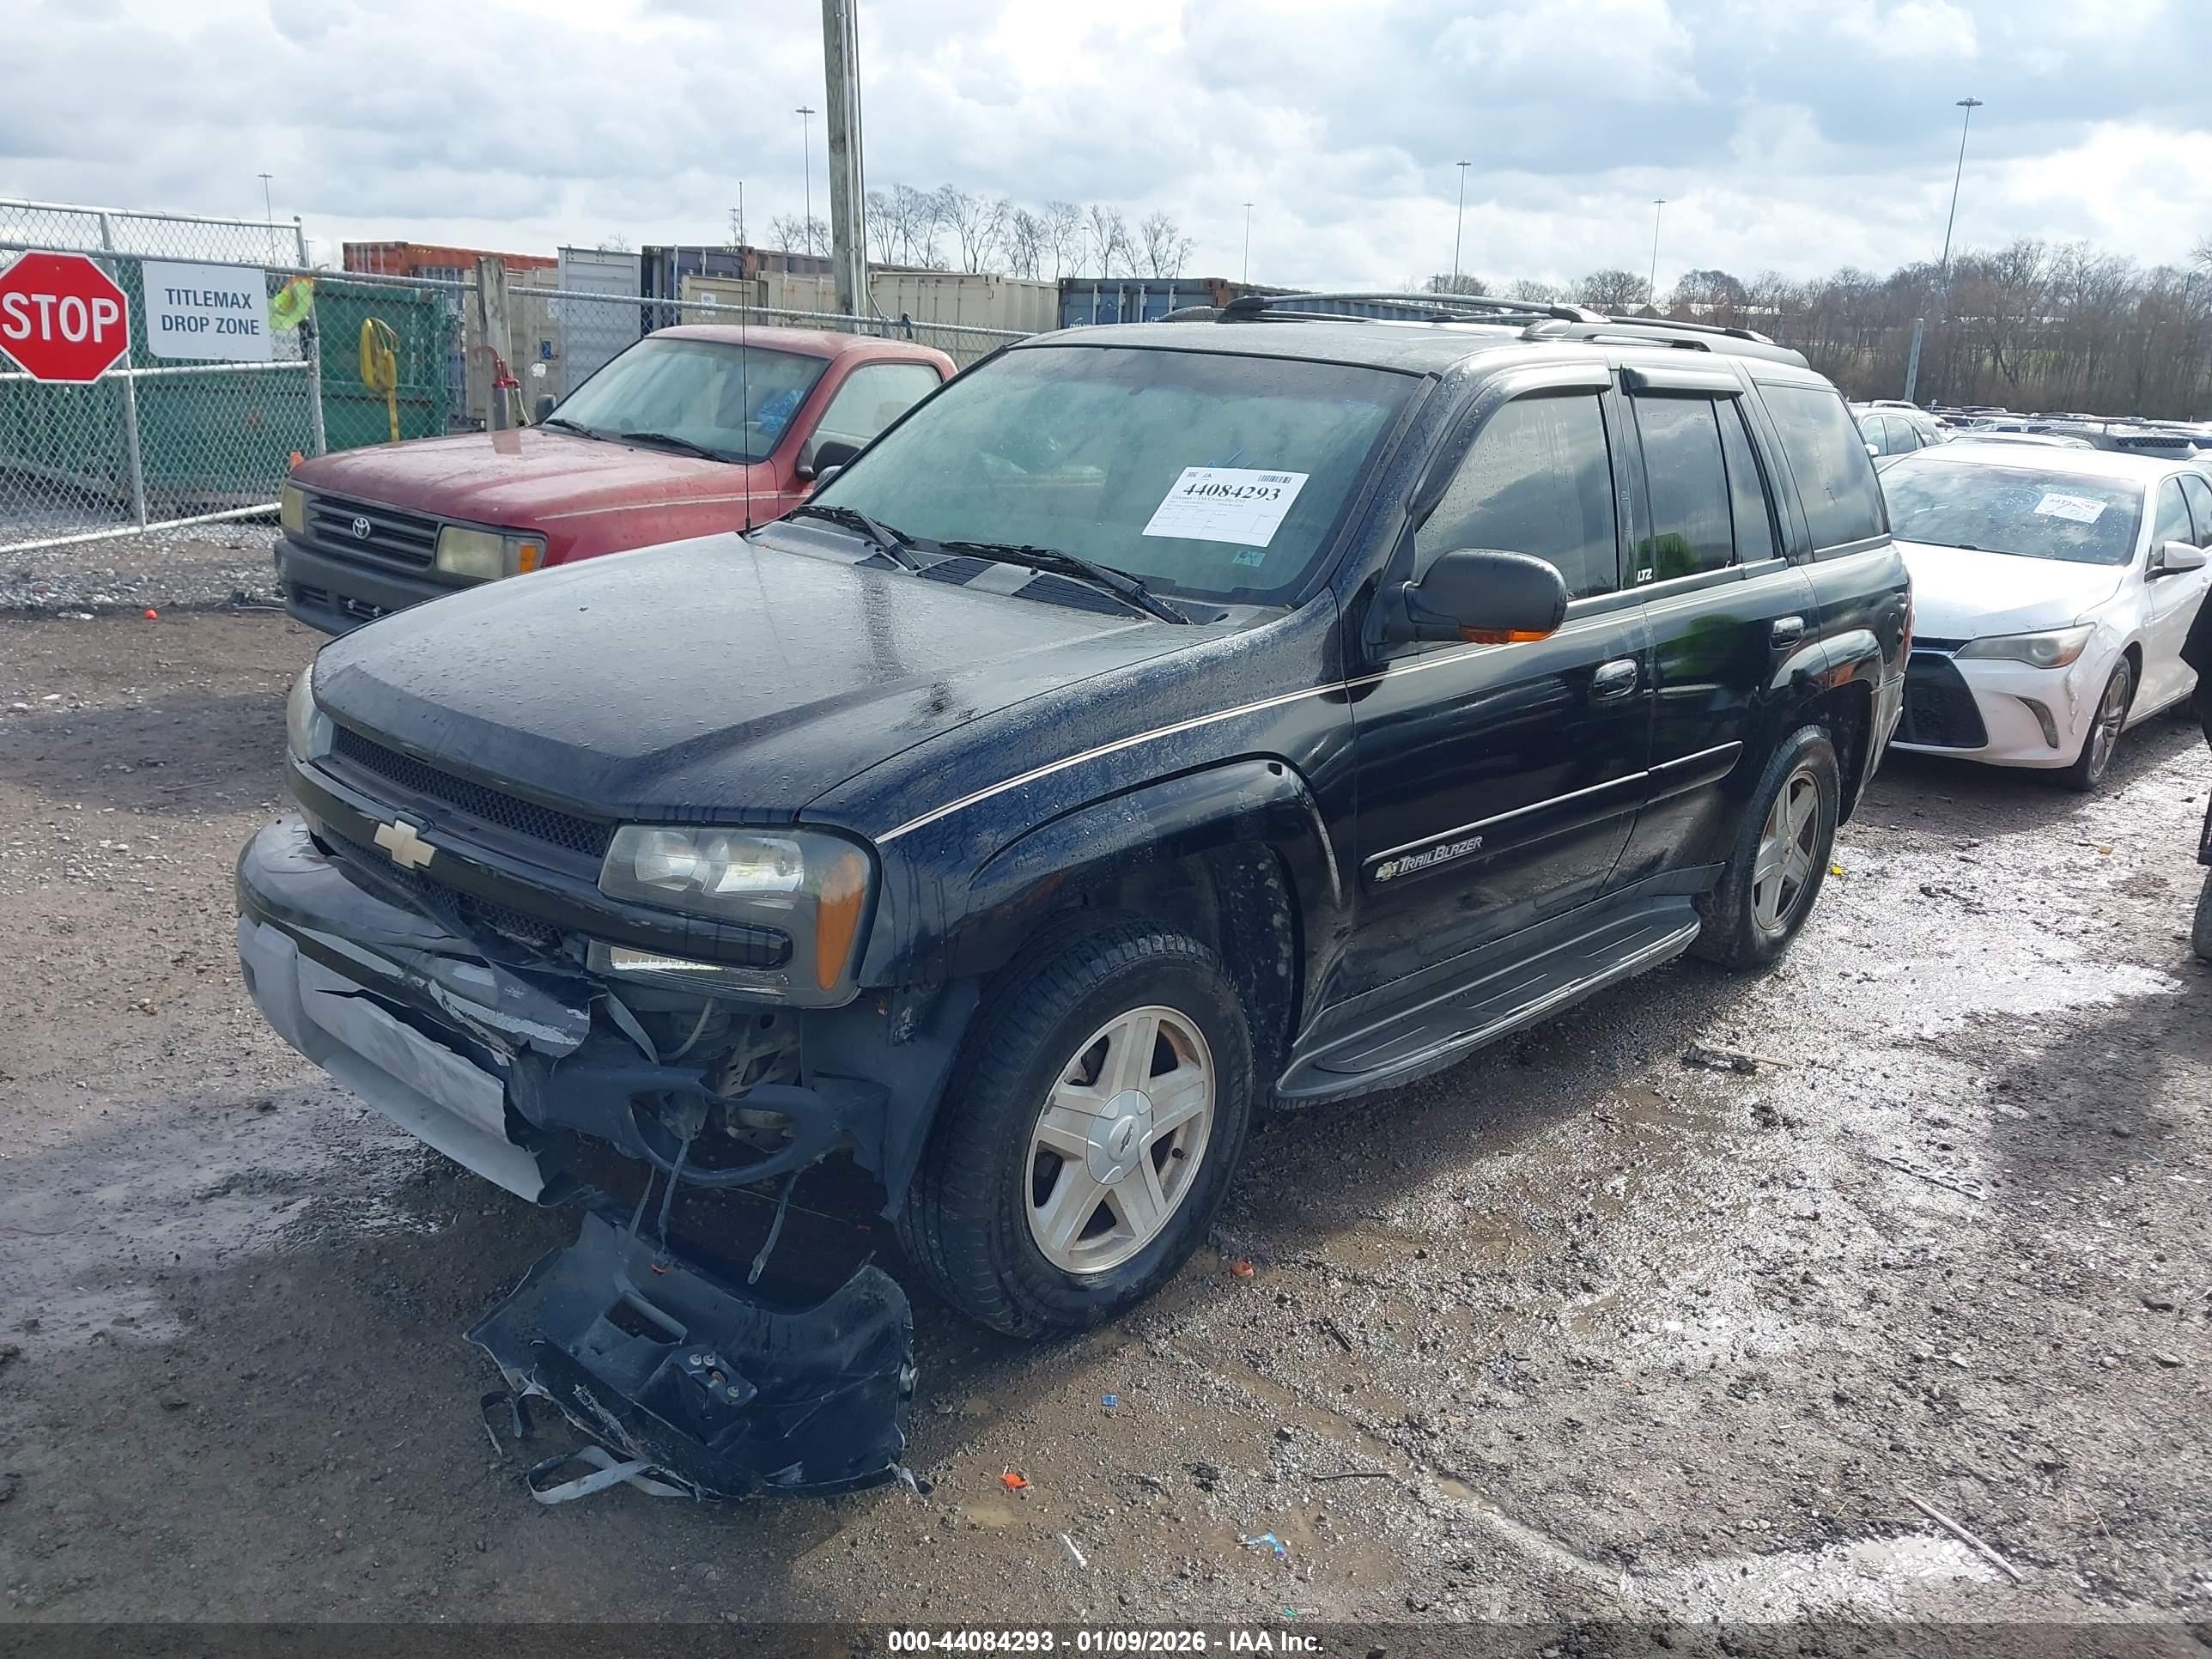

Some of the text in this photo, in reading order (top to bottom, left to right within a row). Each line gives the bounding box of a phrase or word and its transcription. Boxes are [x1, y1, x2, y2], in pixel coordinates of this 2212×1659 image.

[164, 288, 252, 310] TITLEMAX
[2, 291, 119, 343] STOP
[161, 314, 260, 336] DROP ZONE
[1182, 483, 1281, 501] 44084293
[1637, 568, 1653, 582] LTZ
